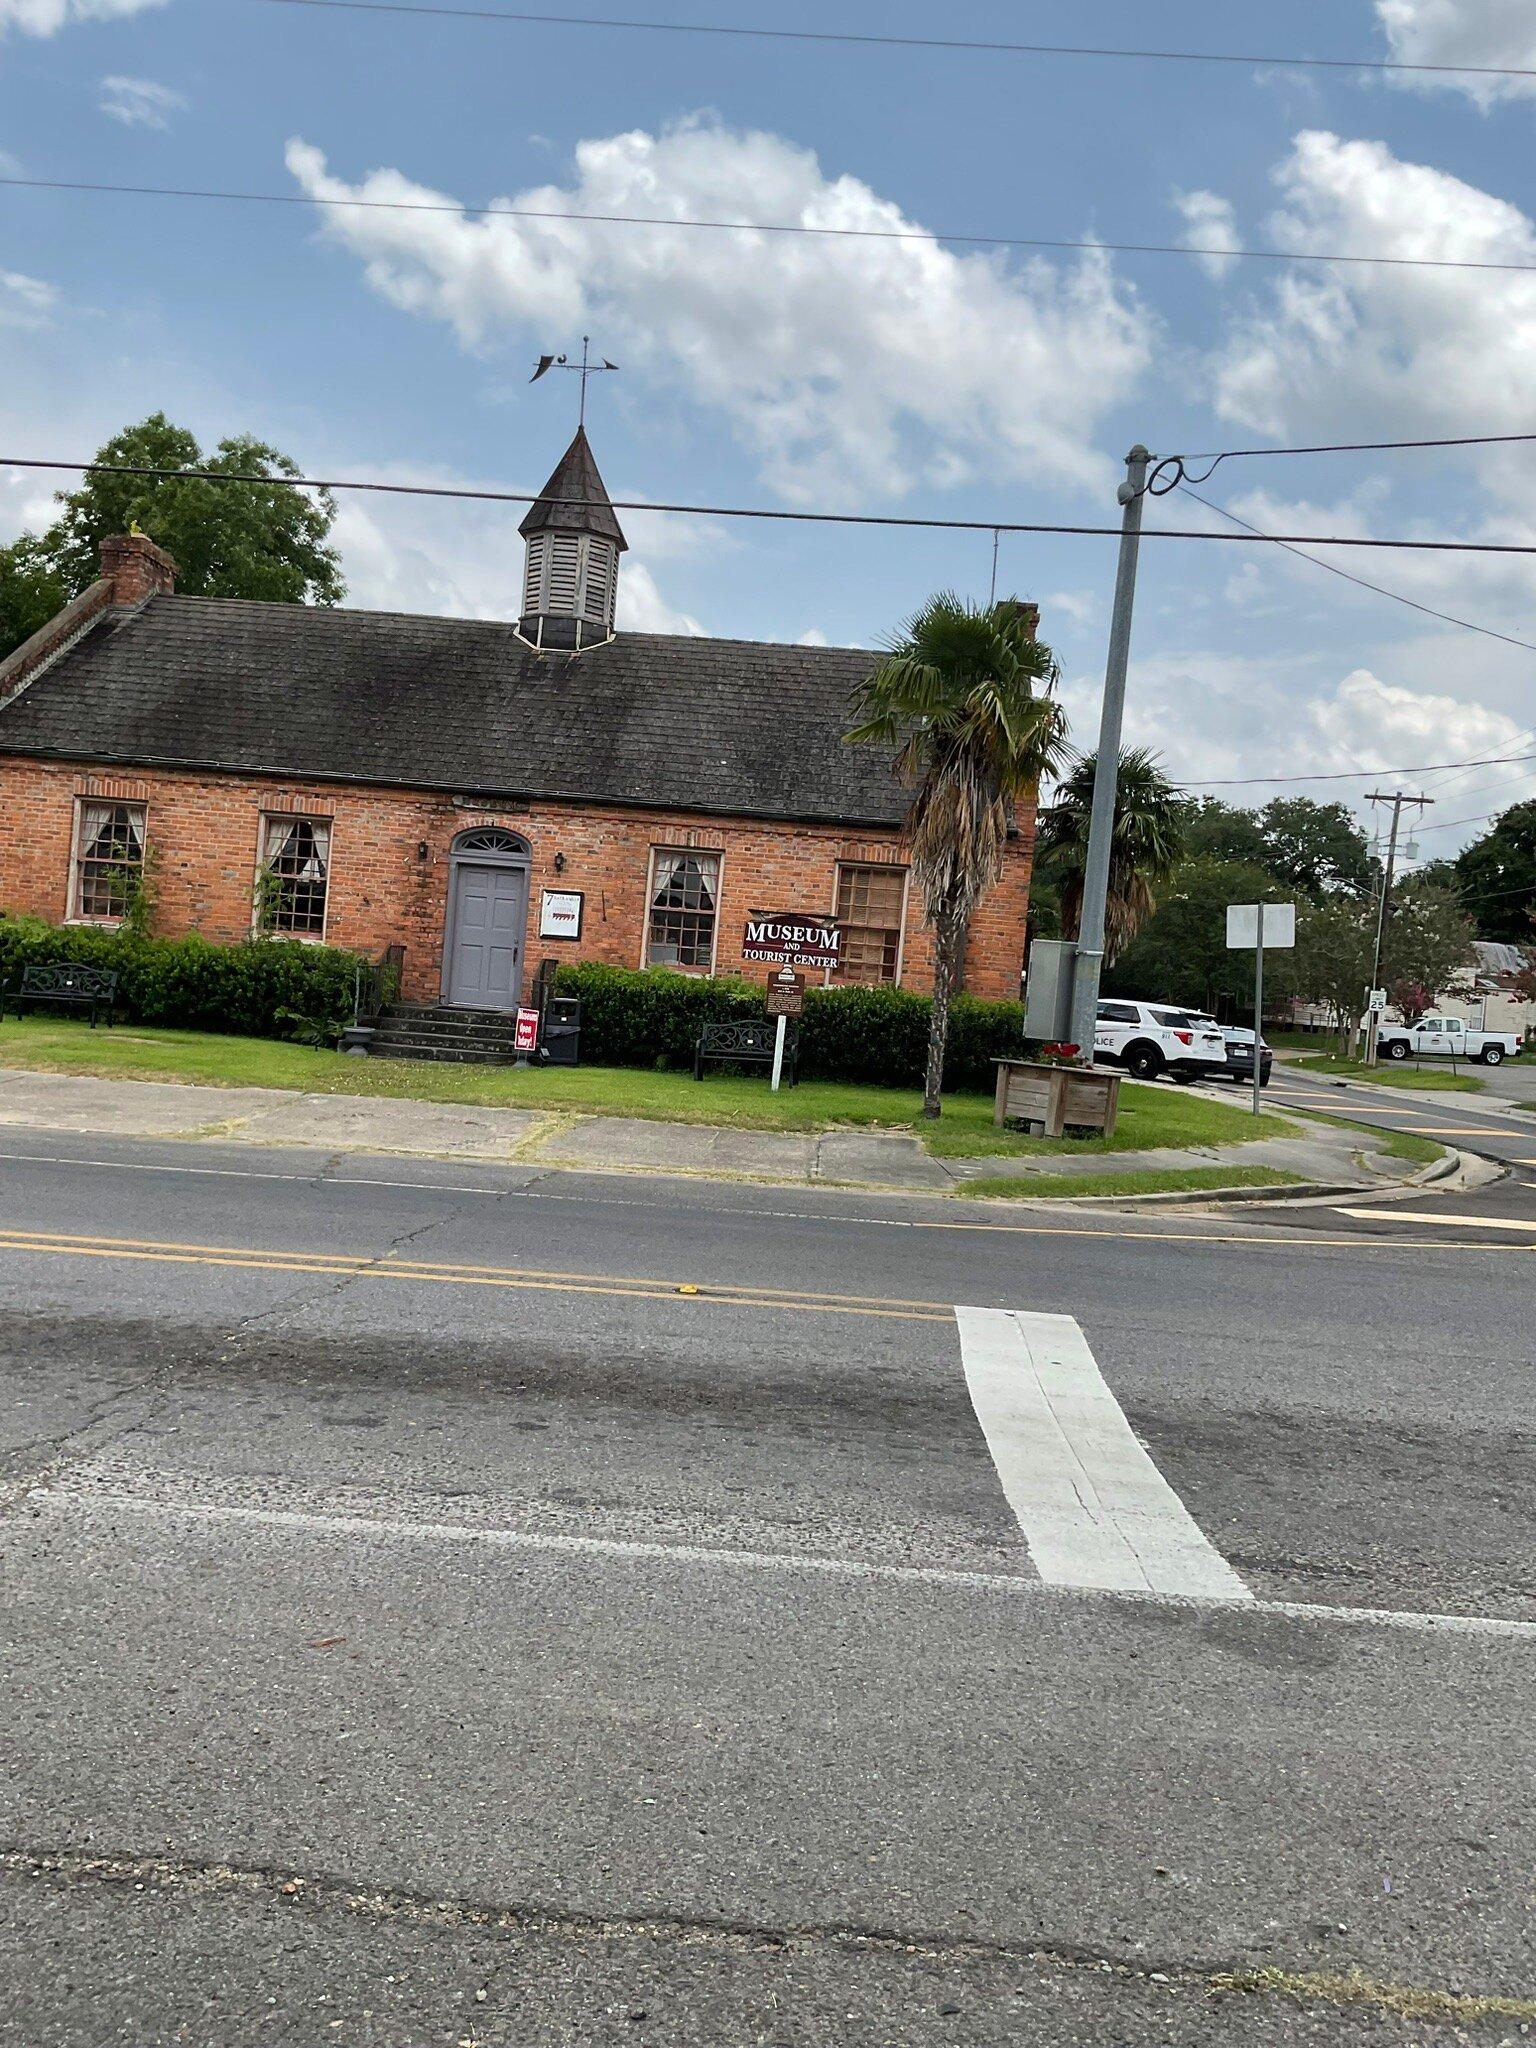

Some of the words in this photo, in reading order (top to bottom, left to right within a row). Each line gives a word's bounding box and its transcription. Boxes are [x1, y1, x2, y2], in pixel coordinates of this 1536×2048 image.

[745, 922, 840, 950] MUSEUM
[783, 942, 800, 951] AND
[743, 949, 792, 963] TOURIST
[793, 954, 838, 968] CENTER
[1371, 1001, 1384, 1010] 25
